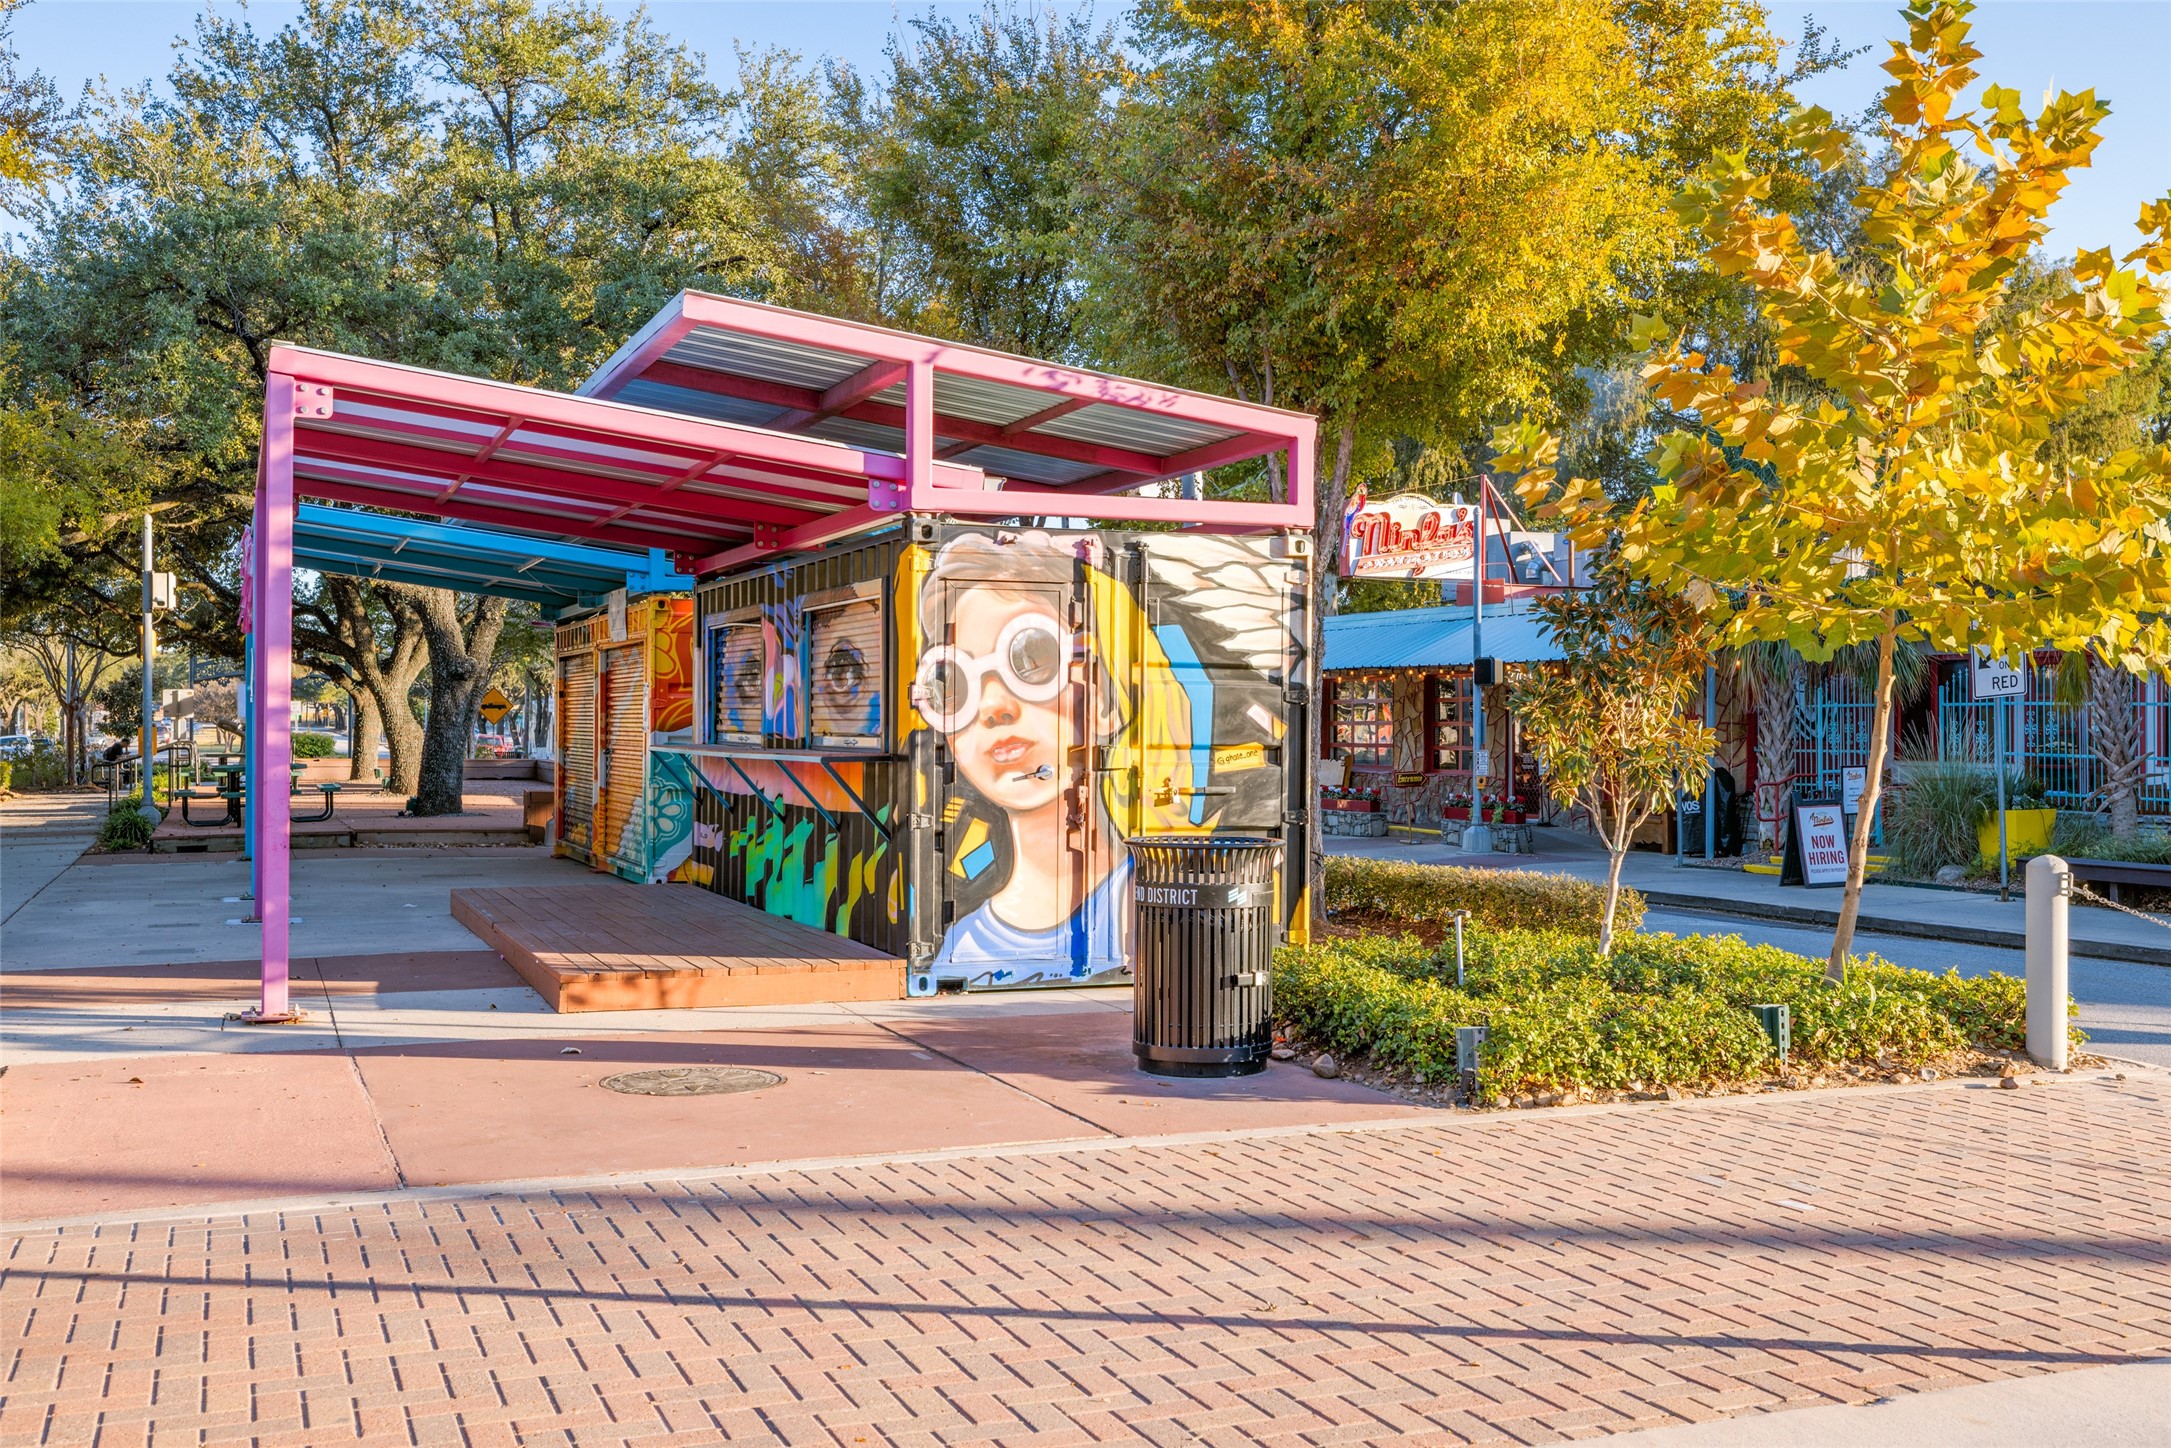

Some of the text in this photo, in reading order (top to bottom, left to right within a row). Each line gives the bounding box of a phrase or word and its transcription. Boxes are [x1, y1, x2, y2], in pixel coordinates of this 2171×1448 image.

[1992, 675, 2018, 691] RED
[1397, 774, 1423, 783] Entrance
[1811, 835, 1834, 849] NOW
[1808, 850, 1845, 866] HIRING
[1147, 888, 1198, 905] DISTRICT
